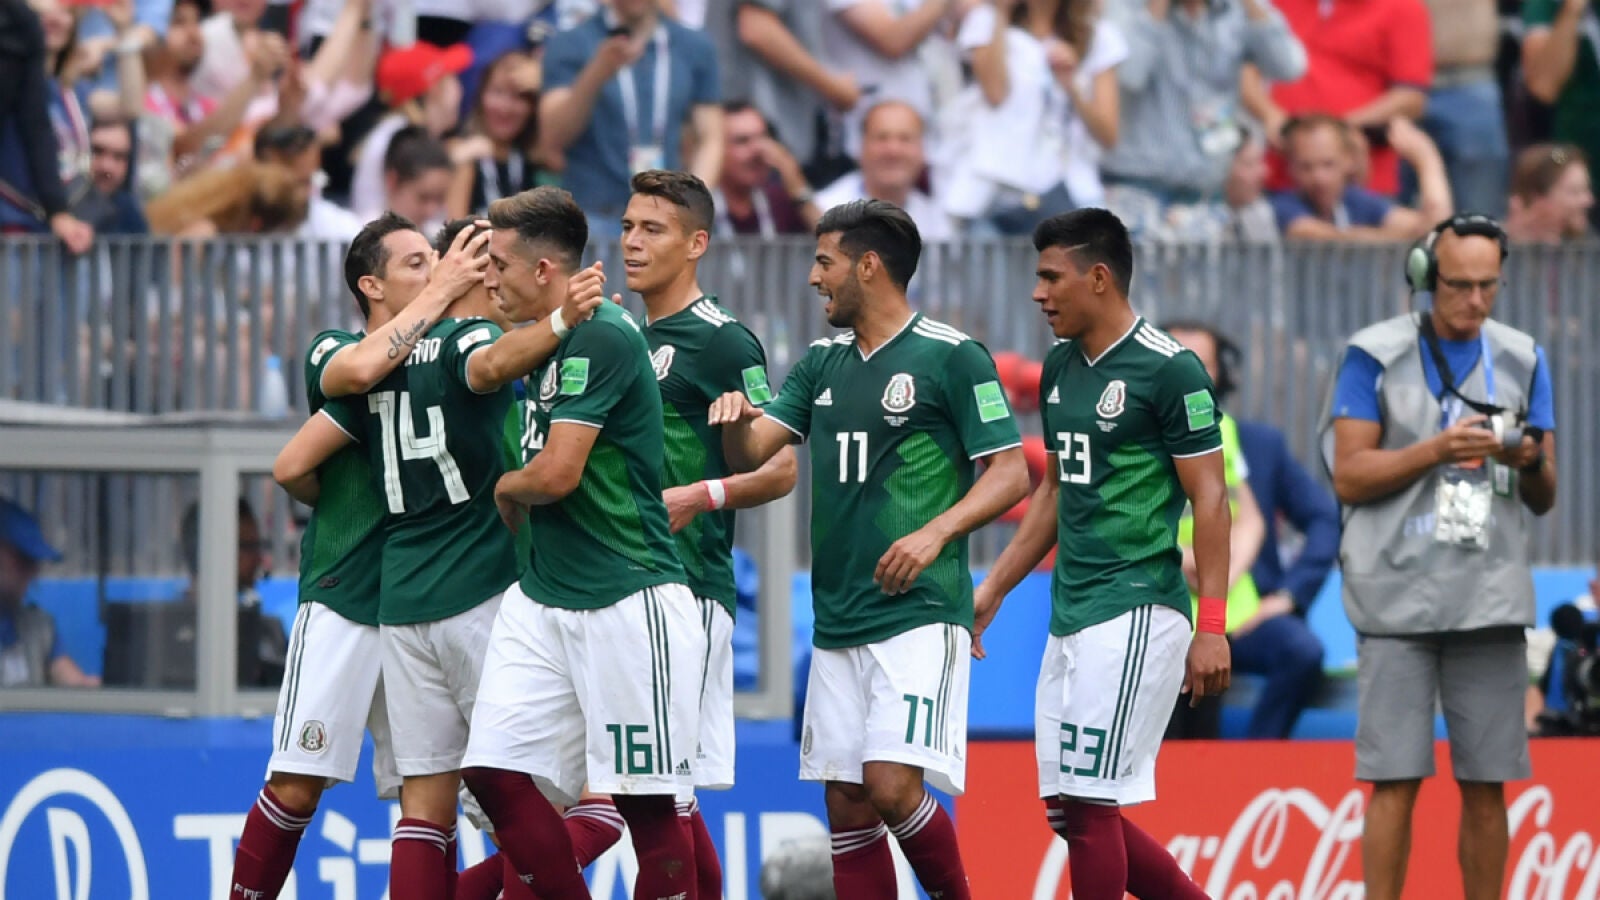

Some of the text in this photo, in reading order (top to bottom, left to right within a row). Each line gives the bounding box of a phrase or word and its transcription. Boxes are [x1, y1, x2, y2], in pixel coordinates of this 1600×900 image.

[367, 390, 471, 514] 14
[836, 431, 868, 483] 11
[1056, 431, 1091, 484] 23
[903, 693, 934, 747] 11
[605, 723, 654, 775] 16
[1060, 722, 1107, 777] 23
